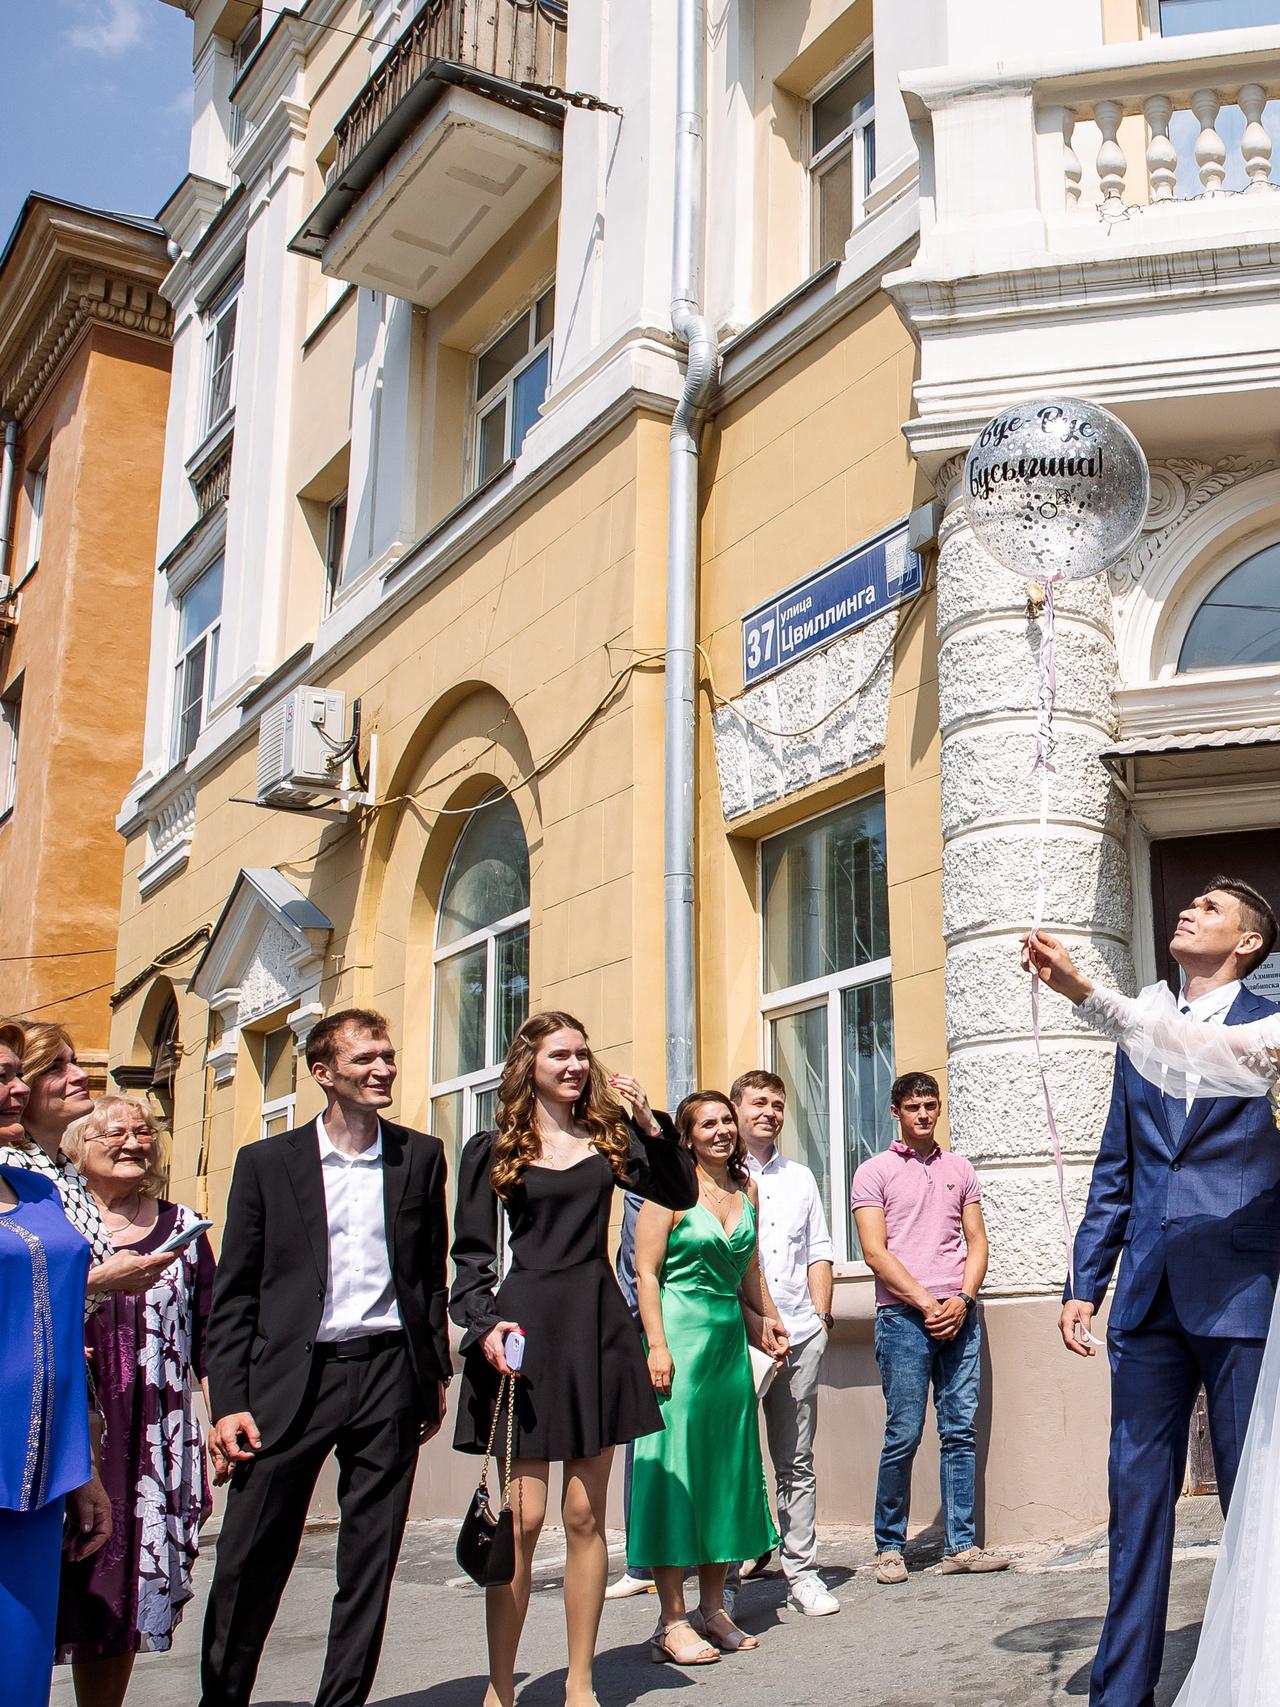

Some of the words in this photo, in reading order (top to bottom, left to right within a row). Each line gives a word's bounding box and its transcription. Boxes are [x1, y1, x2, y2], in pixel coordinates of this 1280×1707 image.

[780, 596, 812, 626] улица
[781, 584, 876, 652] Цвиллинга
[747, 618, 775, 669] 37
